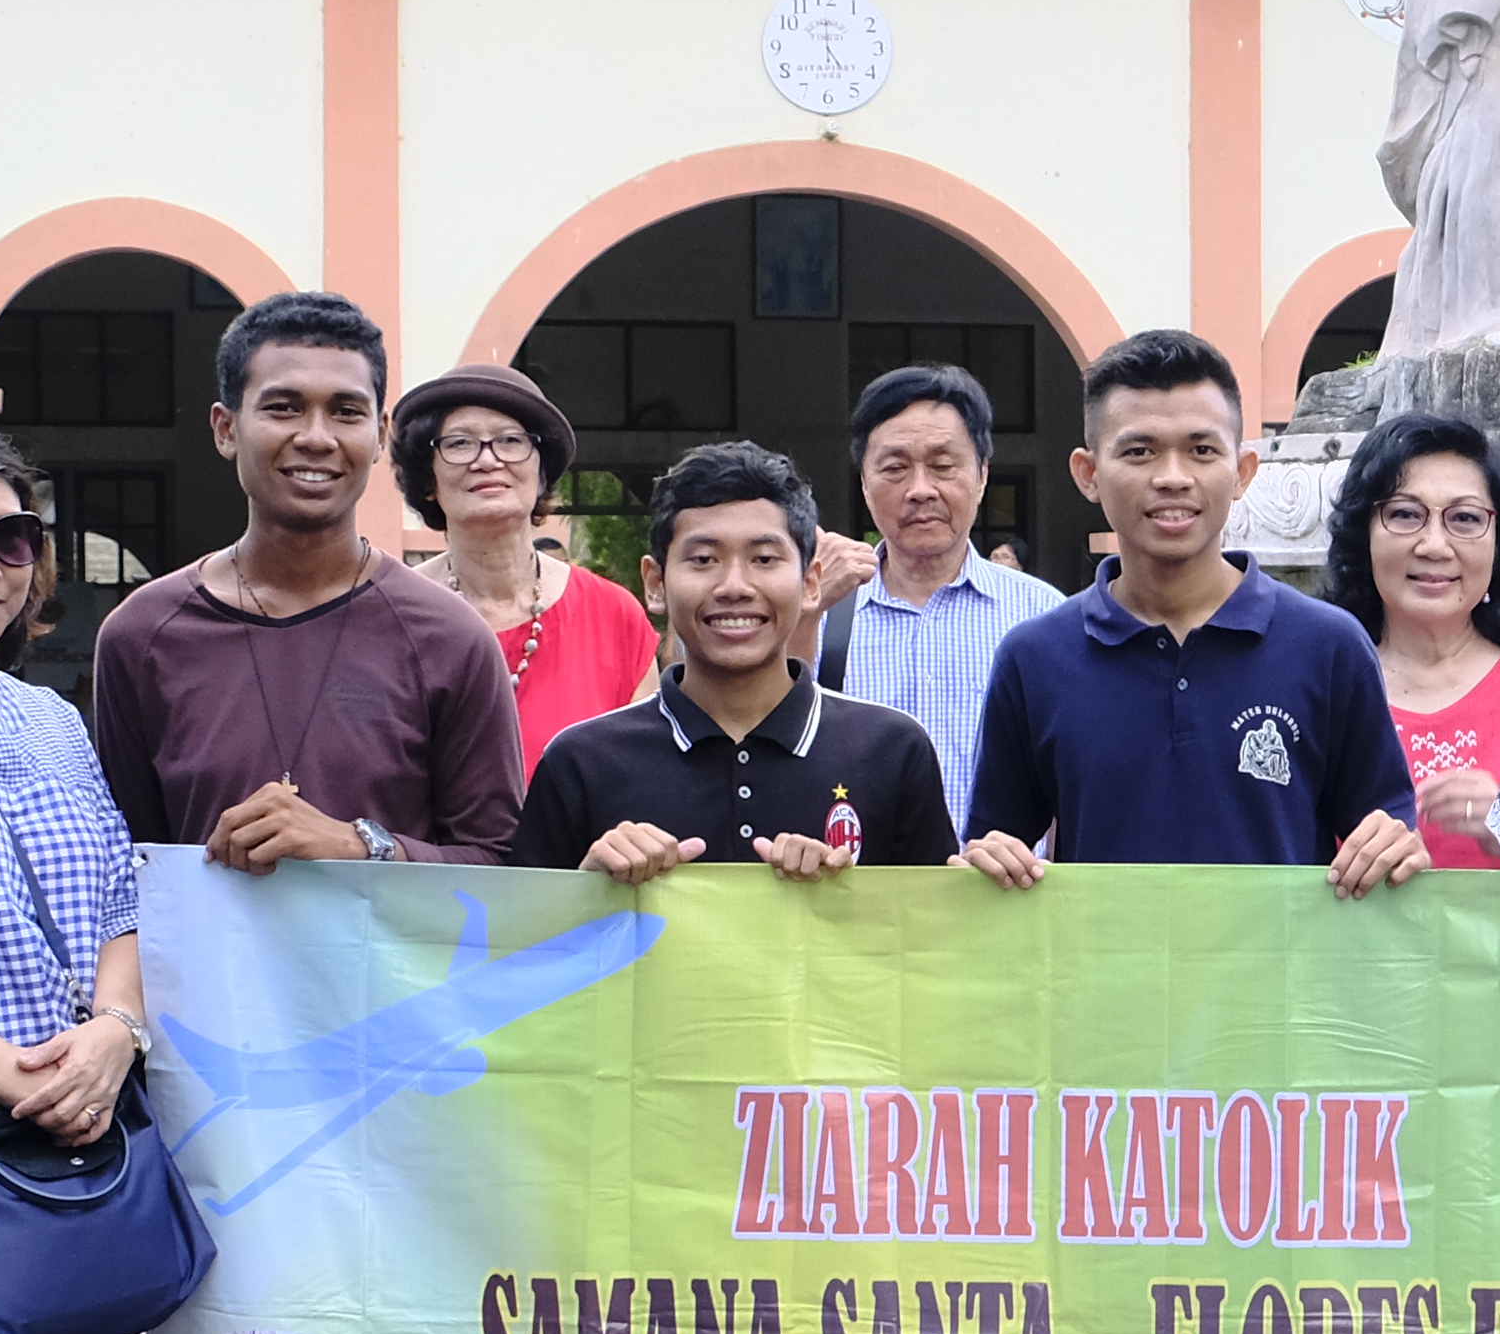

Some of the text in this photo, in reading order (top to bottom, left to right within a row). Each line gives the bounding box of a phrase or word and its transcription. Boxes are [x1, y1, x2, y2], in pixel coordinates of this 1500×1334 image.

[780, 14, 799, 31] 10
[864, 17, 877, 33] 2
[770, 39, 782, 56] 9
[872, 40, 885, 57] 3
[779, 62, 791, 79] 8
[864, 64, 876, 80] 4
[799, 82, 809, 99] 7
[822, 88, 834, 105] 6
[849, 82, 860, 99] 5
[733, 1088, 1409, 1244] ZIARAH KATOLIK
